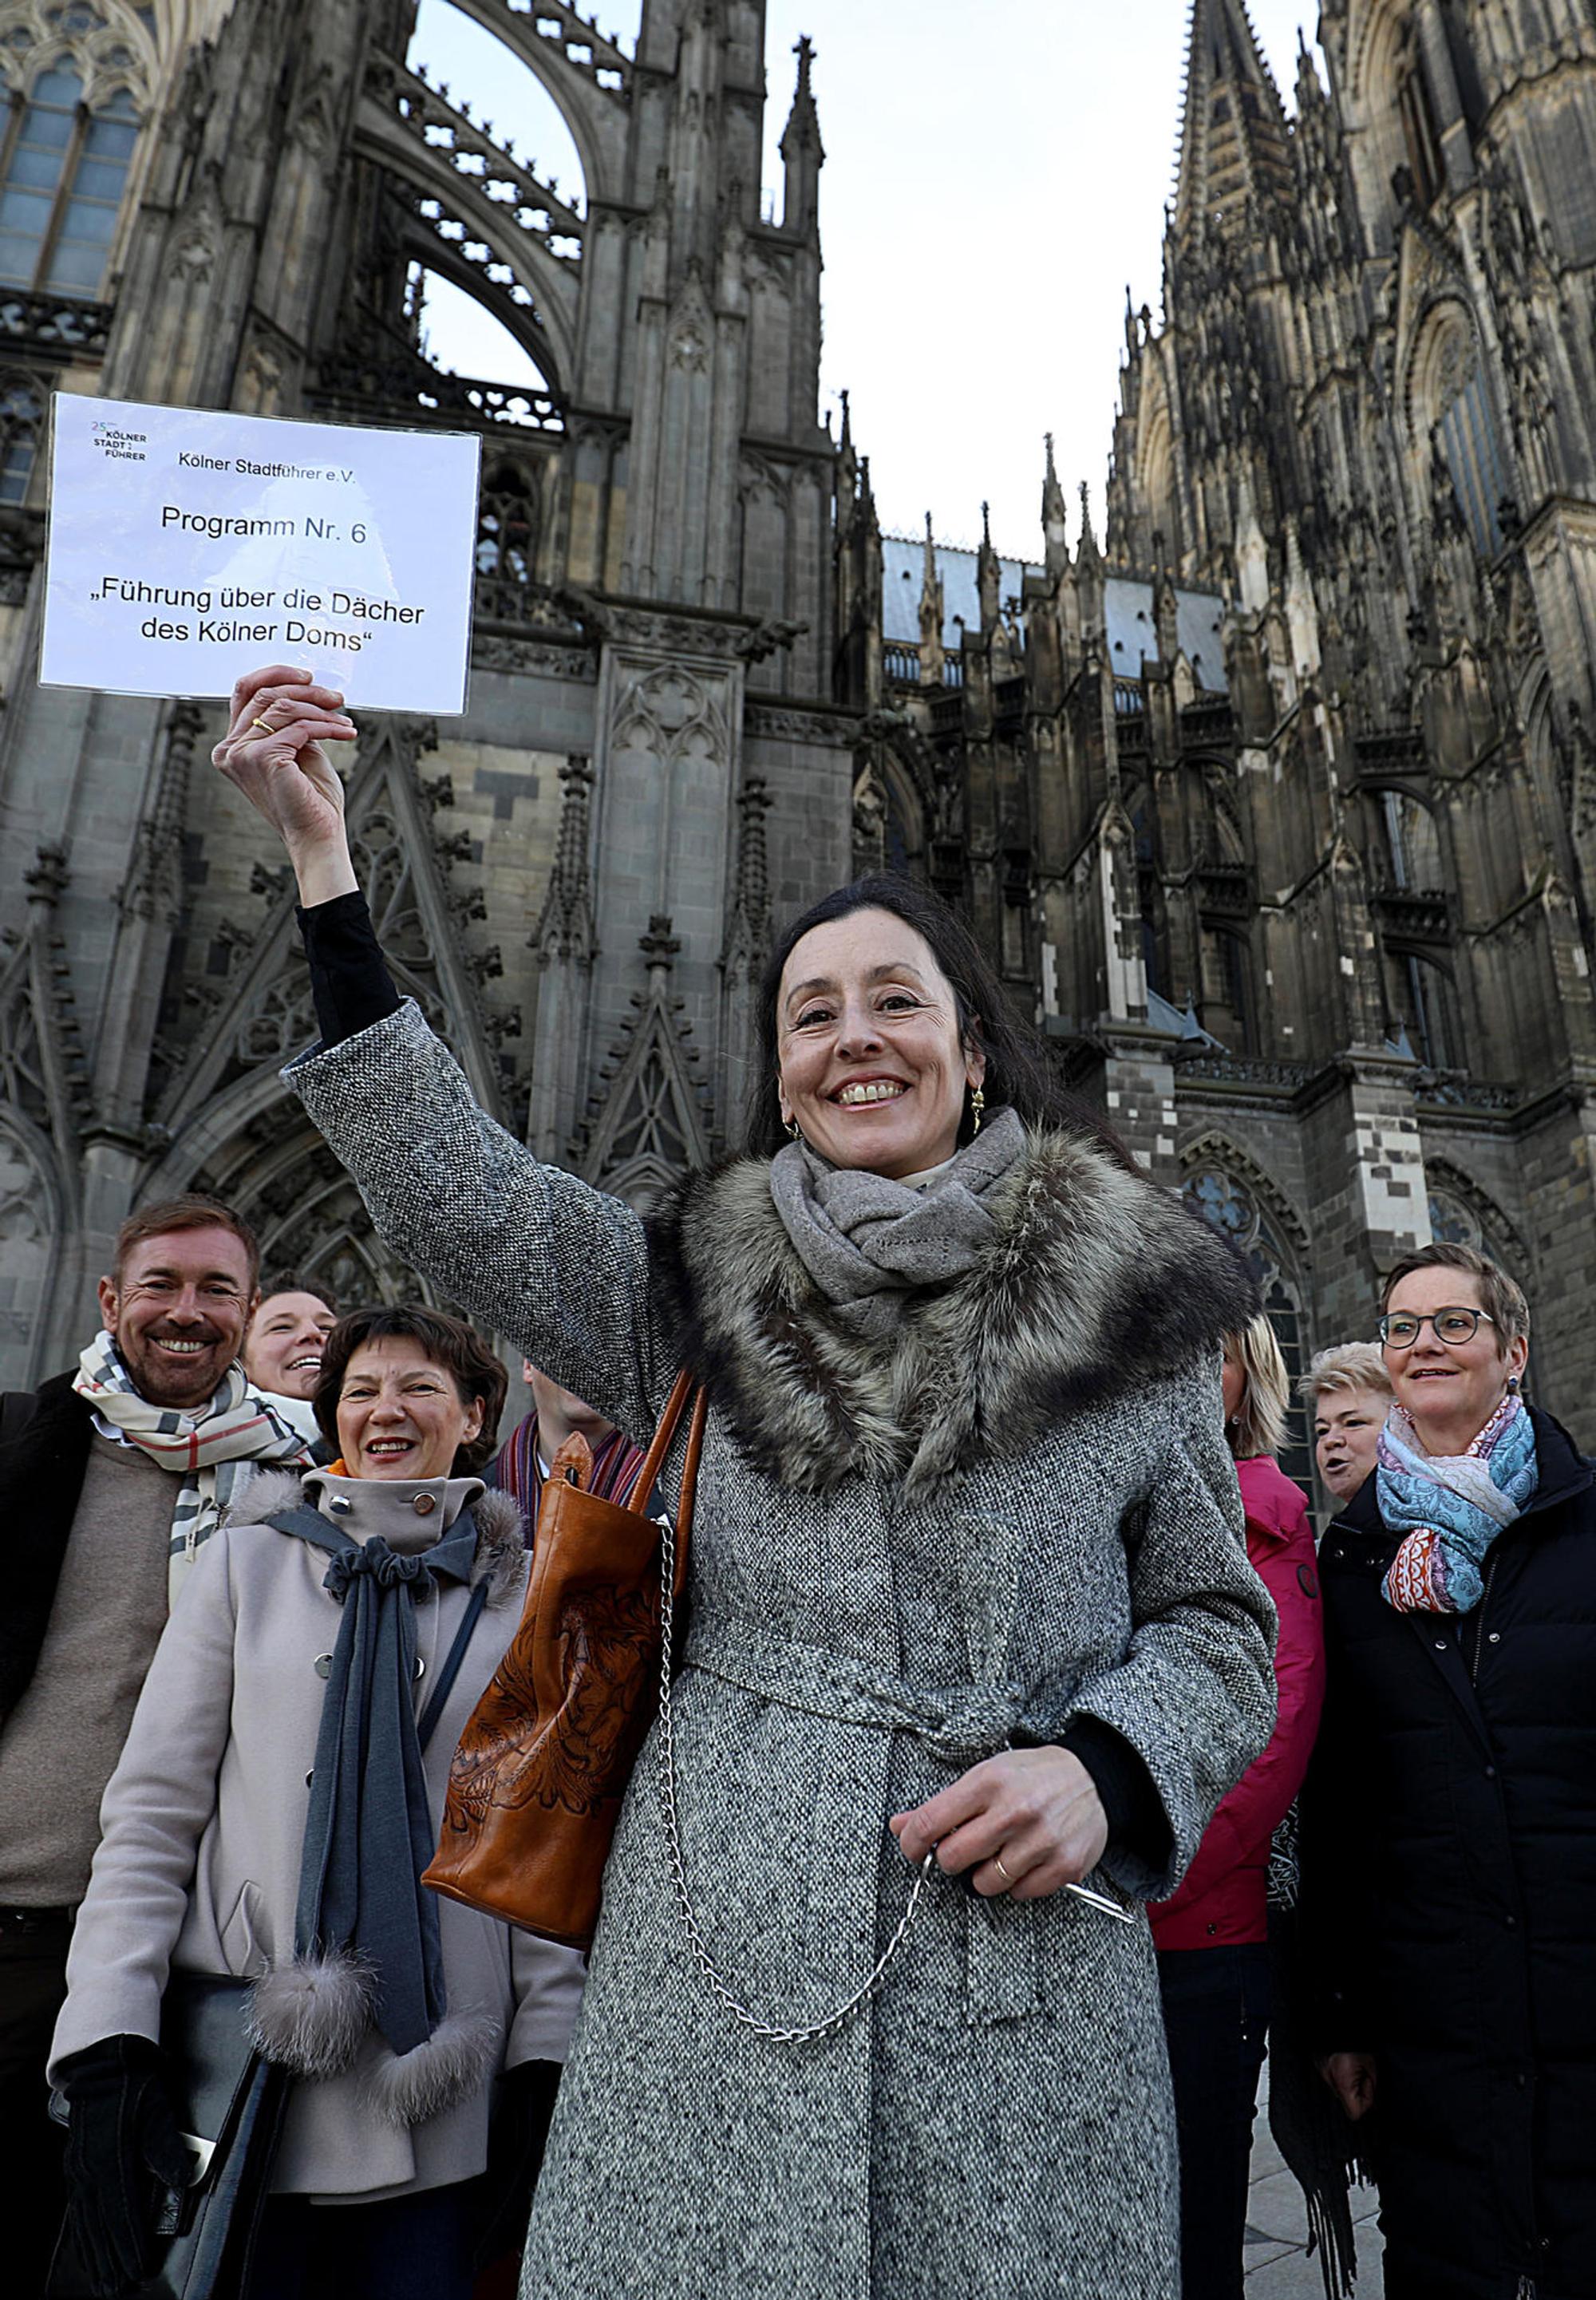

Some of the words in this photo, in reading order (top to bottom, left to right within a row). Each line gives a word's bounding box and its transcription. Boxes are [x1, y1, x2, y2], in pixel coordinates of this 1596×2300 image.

[106, 431, 146, 442] KÖLNER
[105, 449, 145, 460] FÜHRER
[179, 452, 231, 472] Kölner
[235, 459, 322, 480] Stadtführer
[326, 468, 356, 484] e.V.
[161, 507, 294, 539] Programm
[306, 518, 341, 540] Nr.
[351, 524, 366, 543] 6
[221, 588, 275, 610] über
[283, 589, 322, 611] die
[332, 594, 425, 624] Dächer
[141, 618, 188, 641] des
[199, 620, 279, 642] Kölner
